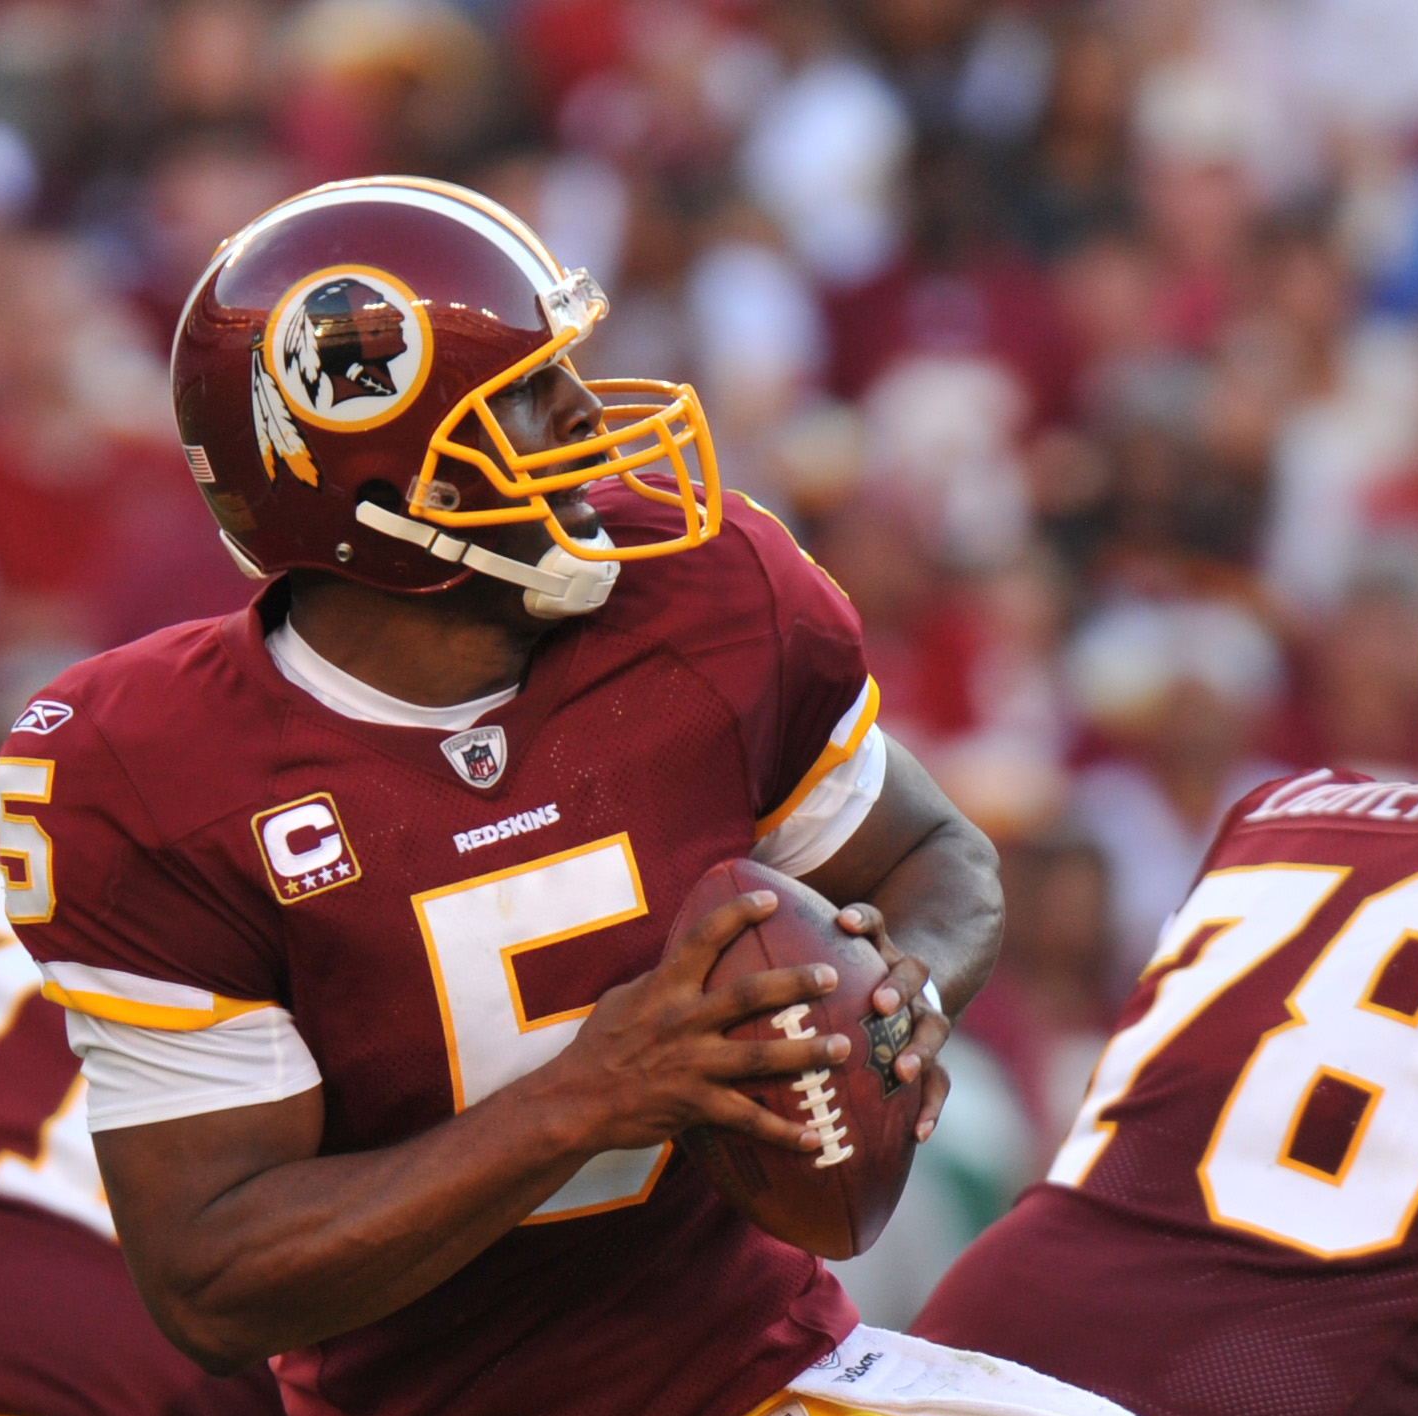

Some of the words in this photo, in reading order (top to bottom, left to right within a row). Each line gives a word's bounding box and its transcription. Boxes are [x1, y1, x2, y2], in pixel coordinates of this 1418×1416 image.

[263, 803, 343, 877] C
[453, 802, 560, 853] REDSKINS
[410, 831, 673, 1225] 5
